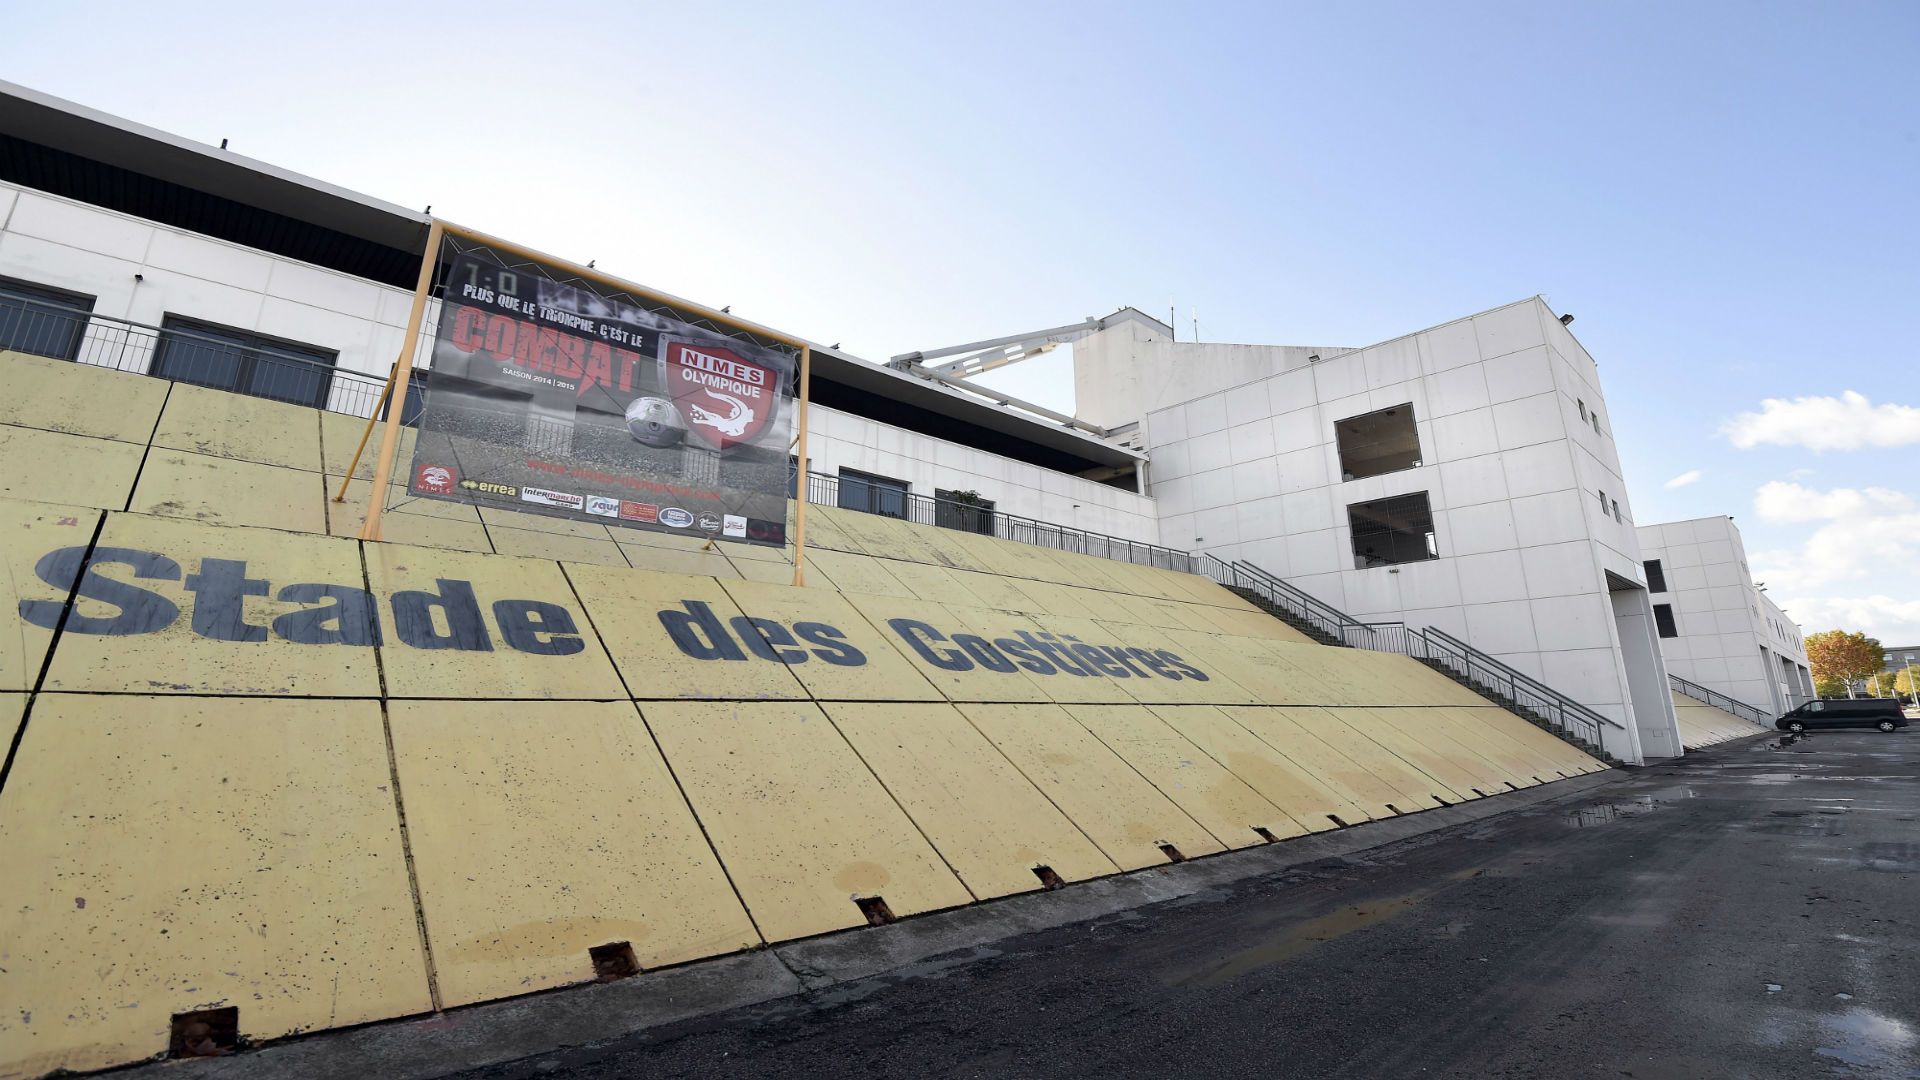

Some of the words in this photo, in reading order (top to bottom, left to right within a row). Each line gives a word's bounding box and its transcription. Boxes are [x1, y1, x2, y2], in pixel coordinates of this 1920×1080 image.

[462, 284, 495, 303] PLUS
[498, 294, 520, 311] QUE
[522, 301, 536, 316] LE
[600, 324, 629, 343] C'EST
[631, 333, 643, 347] LE
[452, 305, 641, 398] COMBAT
[685, 351, 761, 382] NIMES
[502, 367, 532, 380] SAISON
[533, 374, 552, 385] 2014
[556, 380, 575, 391] 2015
[682, 368, 761, 398] OLYMPIQUE
[479, 482, 516, 496] errea
[592, 501, 618, 511] saur
[18, 546, 586, 656] Stade
[657, 600, 868, 666] des
[888, 617, 1210, 682] Costières
